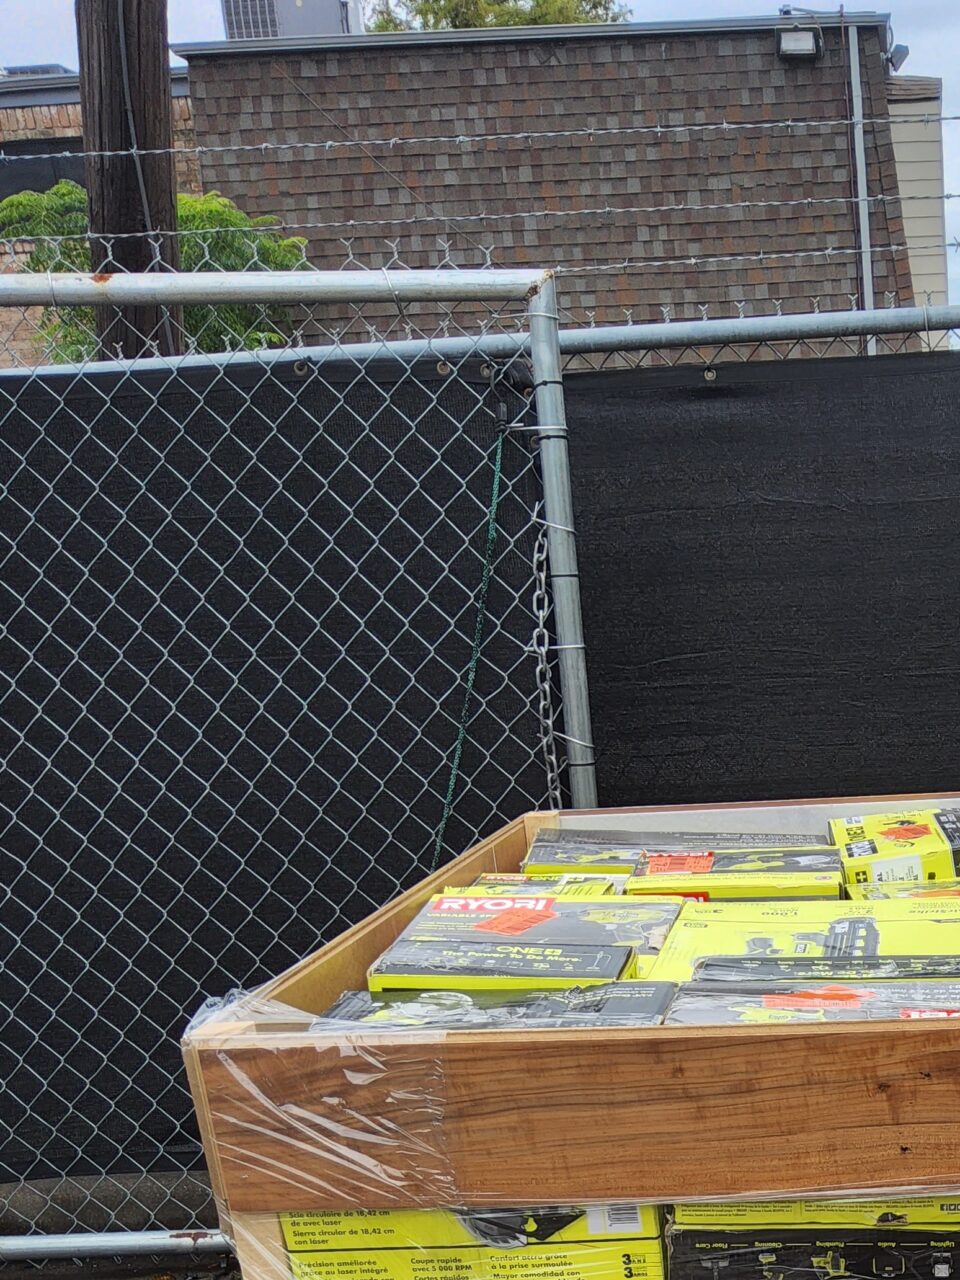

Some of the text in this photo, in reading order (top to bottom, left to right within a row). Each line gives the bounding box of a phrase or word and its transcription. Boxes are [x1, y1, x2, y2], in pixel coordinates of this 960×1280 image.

[438, 899, 549, 910] RYOBI
[293, 1230, 316, 1238] Sierra
[319, 1229, 346, 1237] circular
[755, 1240, 784, 1248] Cleaning
[816, 1240, 845, 1248] Plumbing
[930, 1240, 955, 1248] Lighting
[411, 1257, 463, 1267] Coupe rapide
[622, 1254, 632, 1265] 3
[508, 1261, 528, 1270] prise
[517, 1271, 566, 1279] comodidad
[624, 1267, 633, 1278] 3
